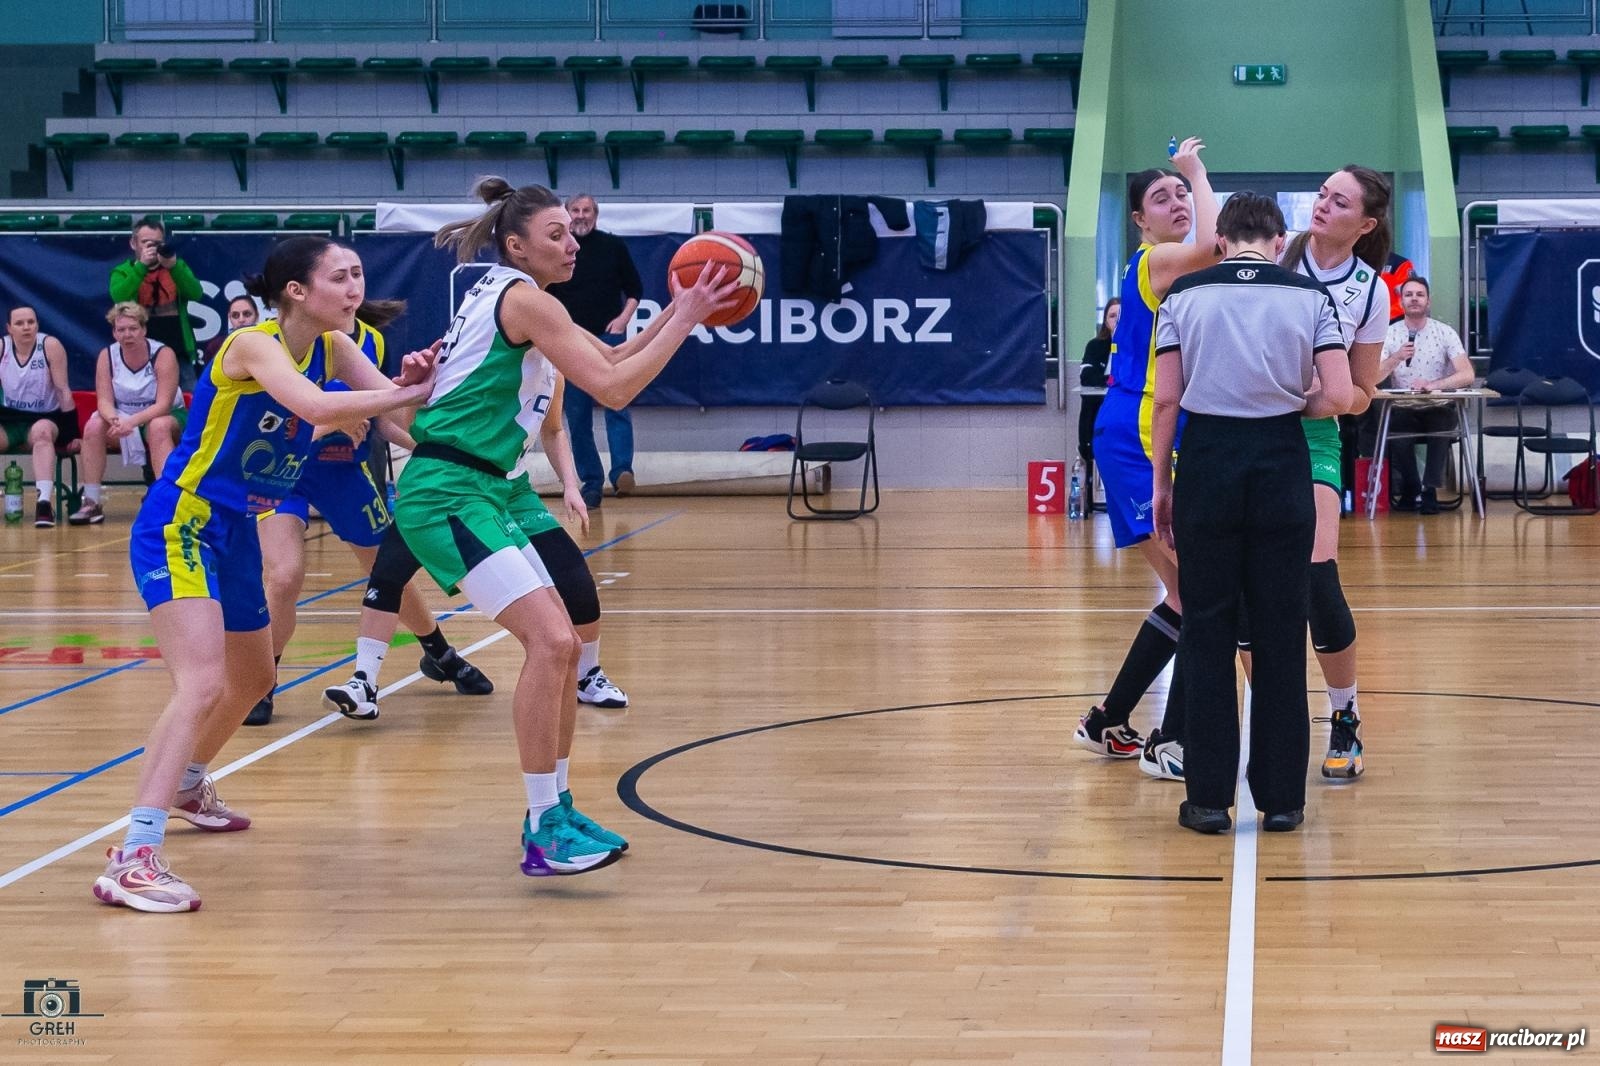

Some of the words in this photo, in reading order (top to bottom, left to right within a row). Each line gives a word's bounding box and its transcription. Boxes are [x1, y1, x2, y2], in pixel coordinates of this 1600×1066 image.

[626, 282, 953, 343] RIBÓRZ
[1343, 286, 1361, 306] 7
[1034, 467, 1058, 502] 5
[362, 497, 387, 530] 13
